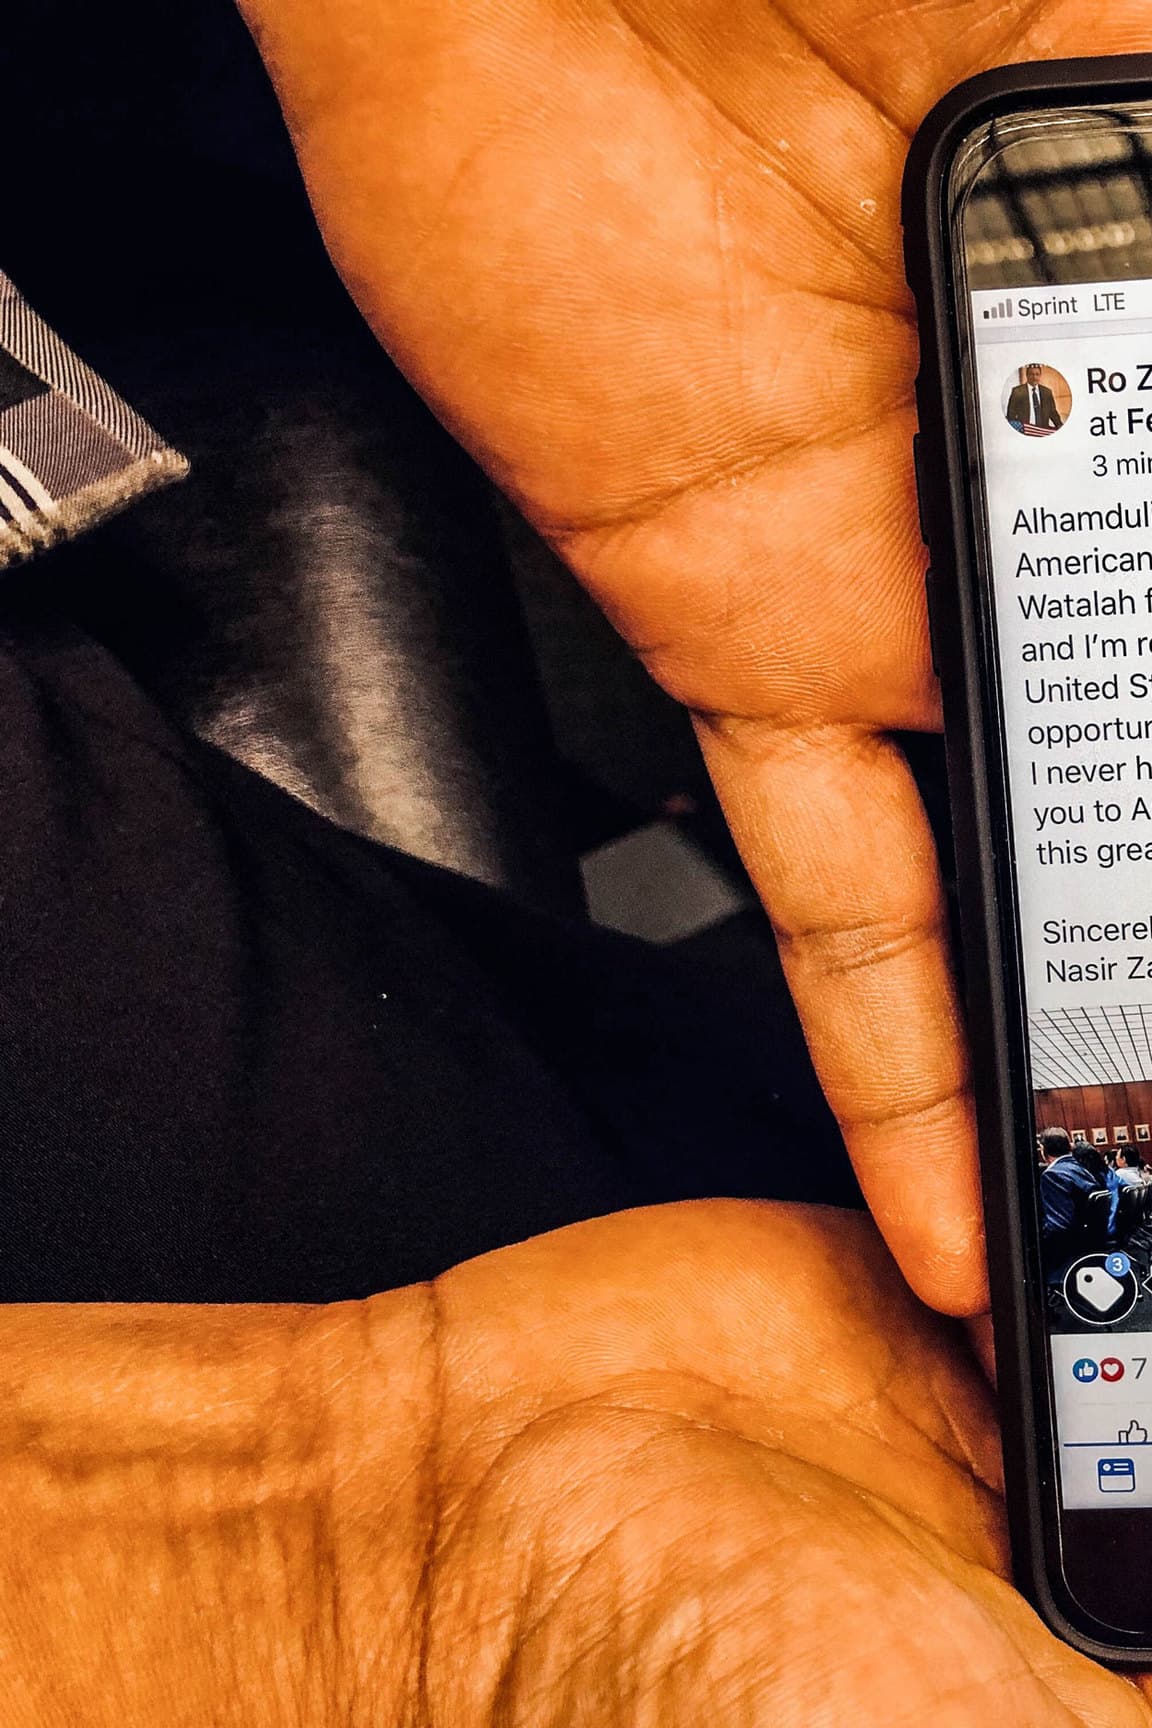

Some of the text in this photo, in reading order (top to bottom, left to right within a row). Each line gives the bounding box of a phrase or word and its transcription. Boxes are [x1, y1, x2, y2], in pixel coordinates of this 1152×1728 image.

[1018, 292, 1126, 321] Sprint LTE
[1087, 367, 1127, 394] Ro
[1090, 411, 1118, 436] at
[1093, 453, 1108, 478] 3
[1017, 589, 1136, 619] Watalah
[1022, 634, 1074, 662] and
[1025, 674, 1119, 703] United
[1032, 762, 1036, 785] I
[1048, 762, 1127, 784] never
[1034, 805, 1084, 831] you
[1093, 800, 1121, 822] to
[1036, 840, 1087, 865] this
[1047, 957, 1117, 983] Nasir
[1113, 1258, 1123, 1271] 3
[1132, 1358, 1147, 1381] 7
